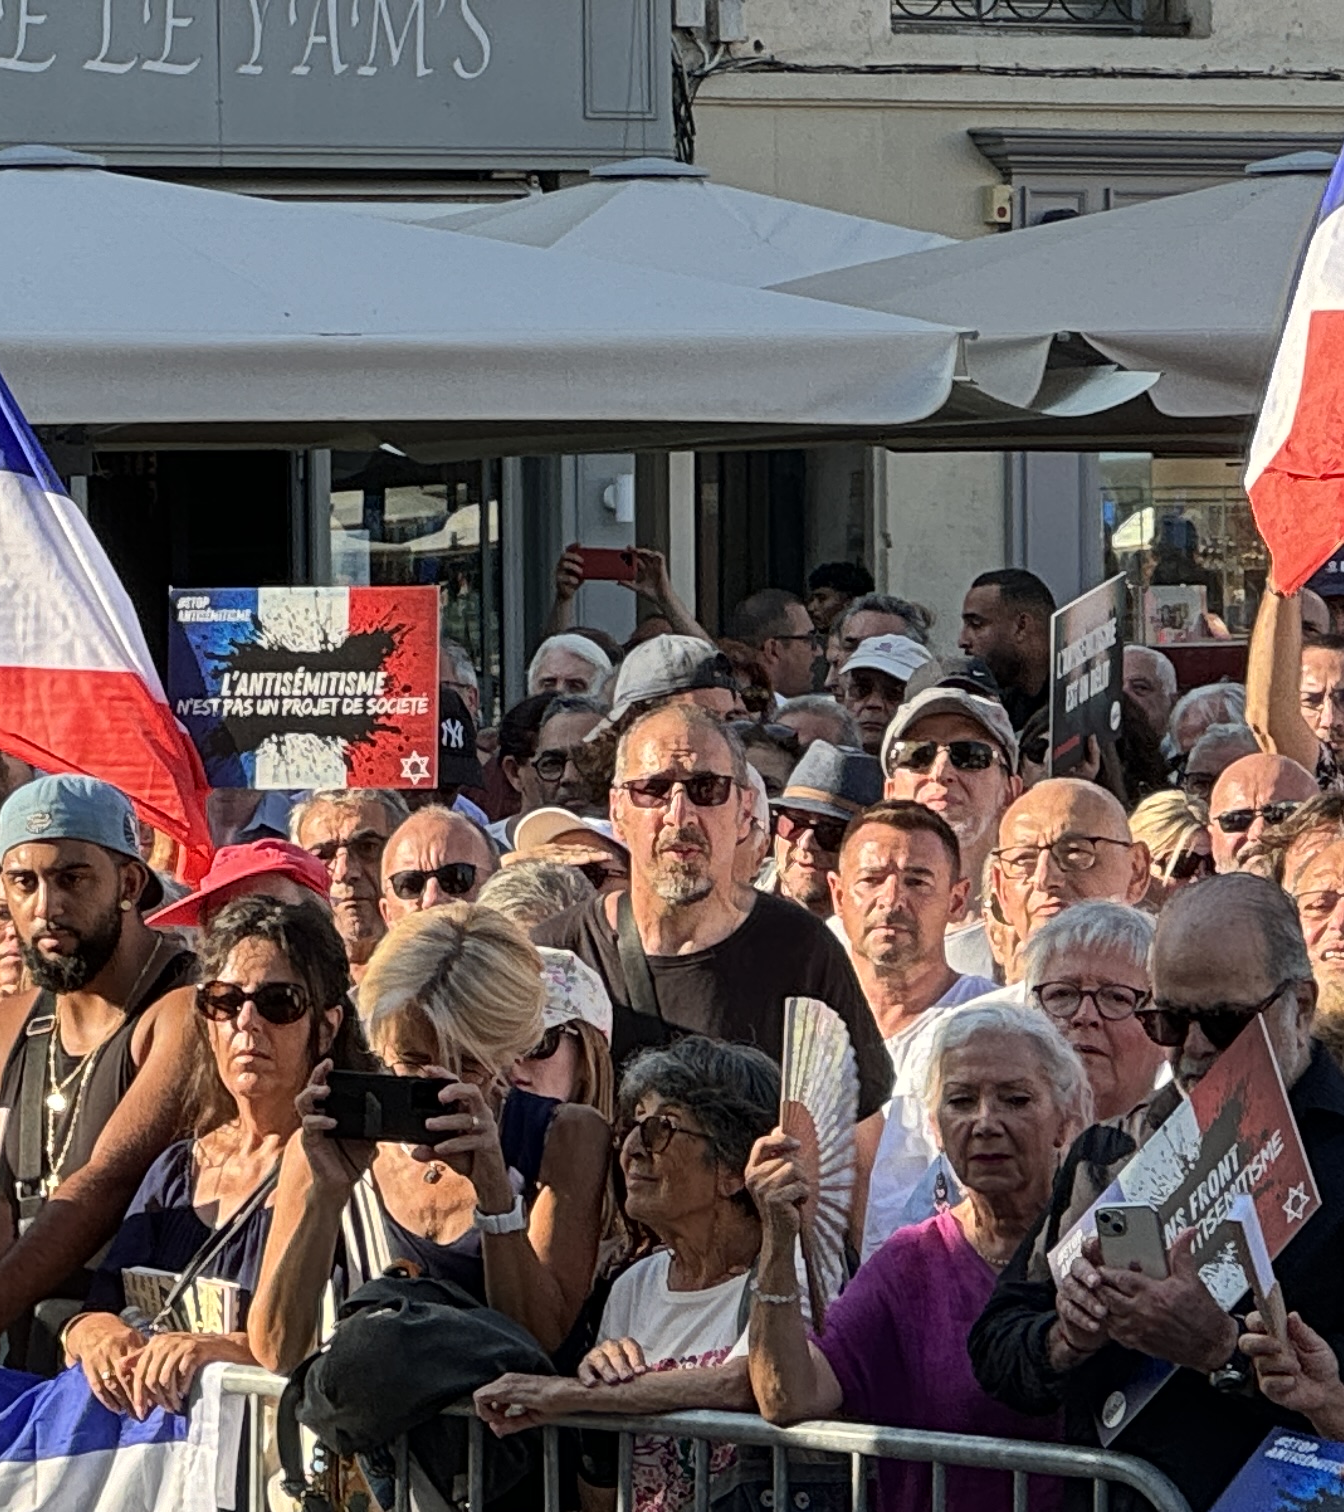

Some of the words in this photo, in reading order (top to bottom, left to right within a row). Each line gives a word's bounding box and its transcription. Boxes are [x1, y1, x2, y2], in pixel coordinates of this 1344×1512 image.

[81, 0, 202, 76] LE
[233, 0, 494, 79] YAM'S
[176, 697, 220, 716] N'EST
[223, 698, 254, 717] PAS
[257, 698, 278, 716] UN
[281, 697, 341, 717] PROJET
[342, 698, 364, 716] DE
[367, 692, 429, 716] SOCIÉTÉ
[220, 666, 388, 698] L'ANTISÉMITISME
[1189, 1142, 1241, 1213] FRONT
